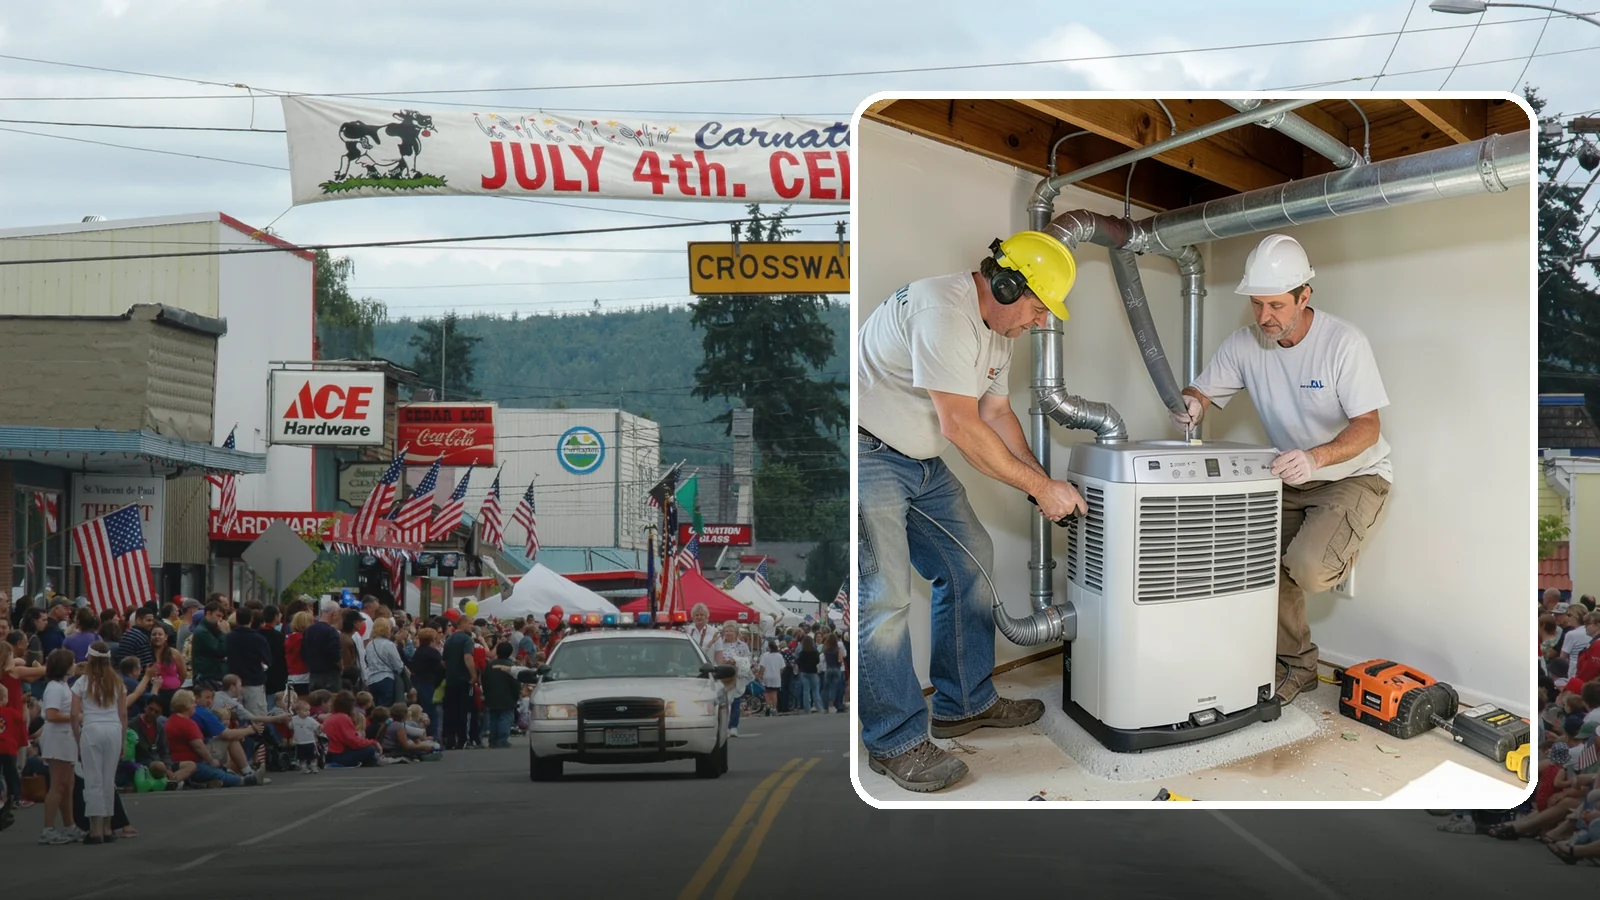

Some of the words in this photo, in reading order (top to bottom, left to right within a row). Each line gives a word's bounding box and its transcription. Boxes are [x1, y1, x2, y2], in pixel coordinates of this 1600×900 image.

[481, 141, 604, 192] JULY
[632, 150, 746, 198] 4th.
[697, 254, 850, 280] CROSSWA
[283, 380, 373, 420] ACE
[405, 409, 452, 422] CEDAR
[284, 421, 371, 436] Hardware
[83, 484, 94, 494] St.
[94, 485, 124, 495] Vincent
[126, 486, 136, 494] de
[137, 486, 155, 495] Paul
[81, 503, 154, 522] THRT
[688, 526, 741, 535] CRNATION
[699, 535, 730, 543] GLASS
